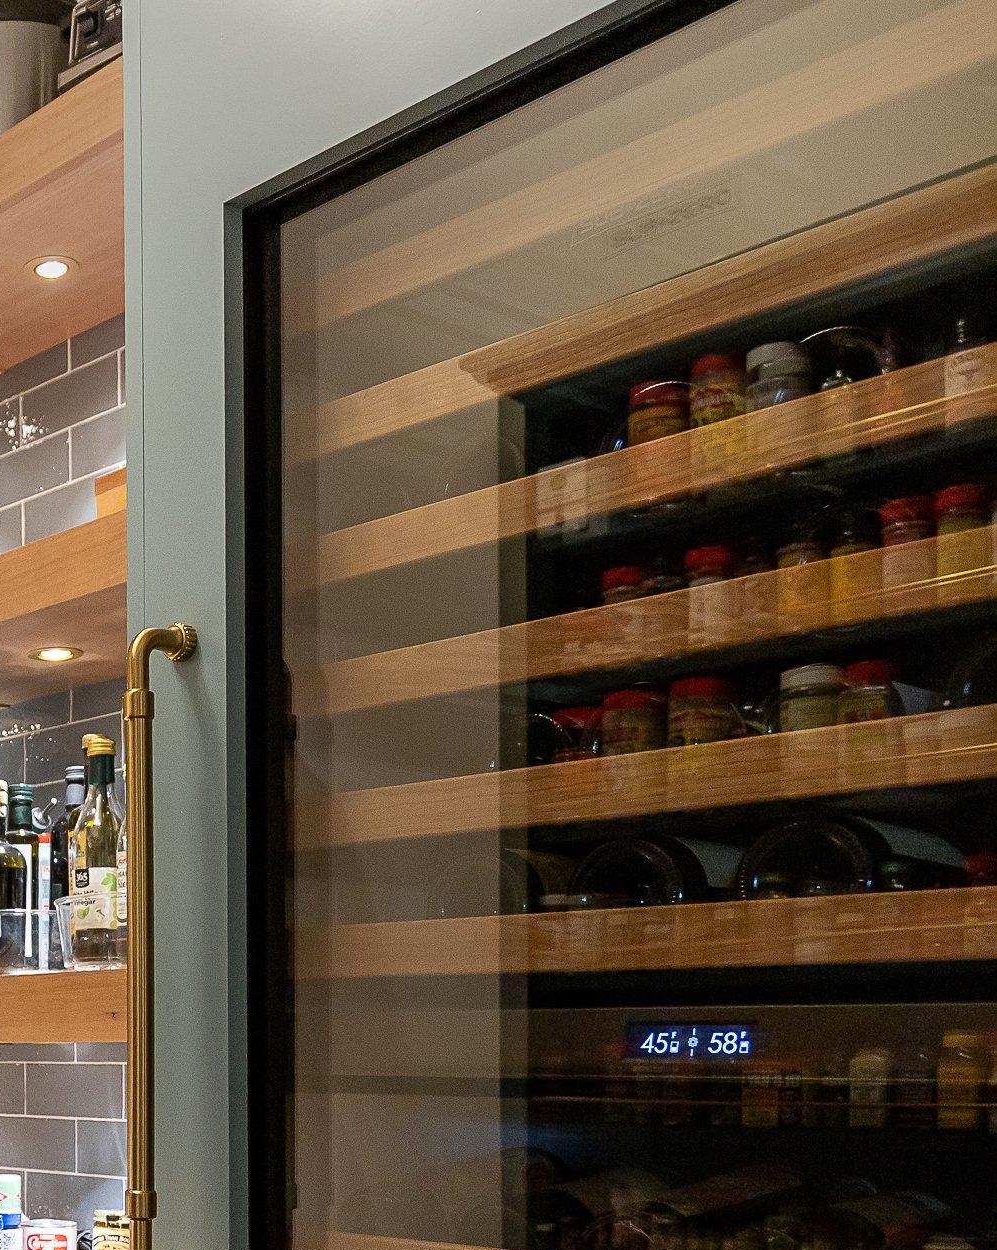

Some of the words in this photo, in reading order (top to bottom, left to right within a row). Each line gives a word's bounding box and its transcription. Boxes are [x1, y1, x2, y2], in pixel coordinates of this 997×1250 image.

[640, 1032, 669, 1054] 45
[707, 1032, 738, 1054] 58
[27, 1235, 68, 1250] Carnation
